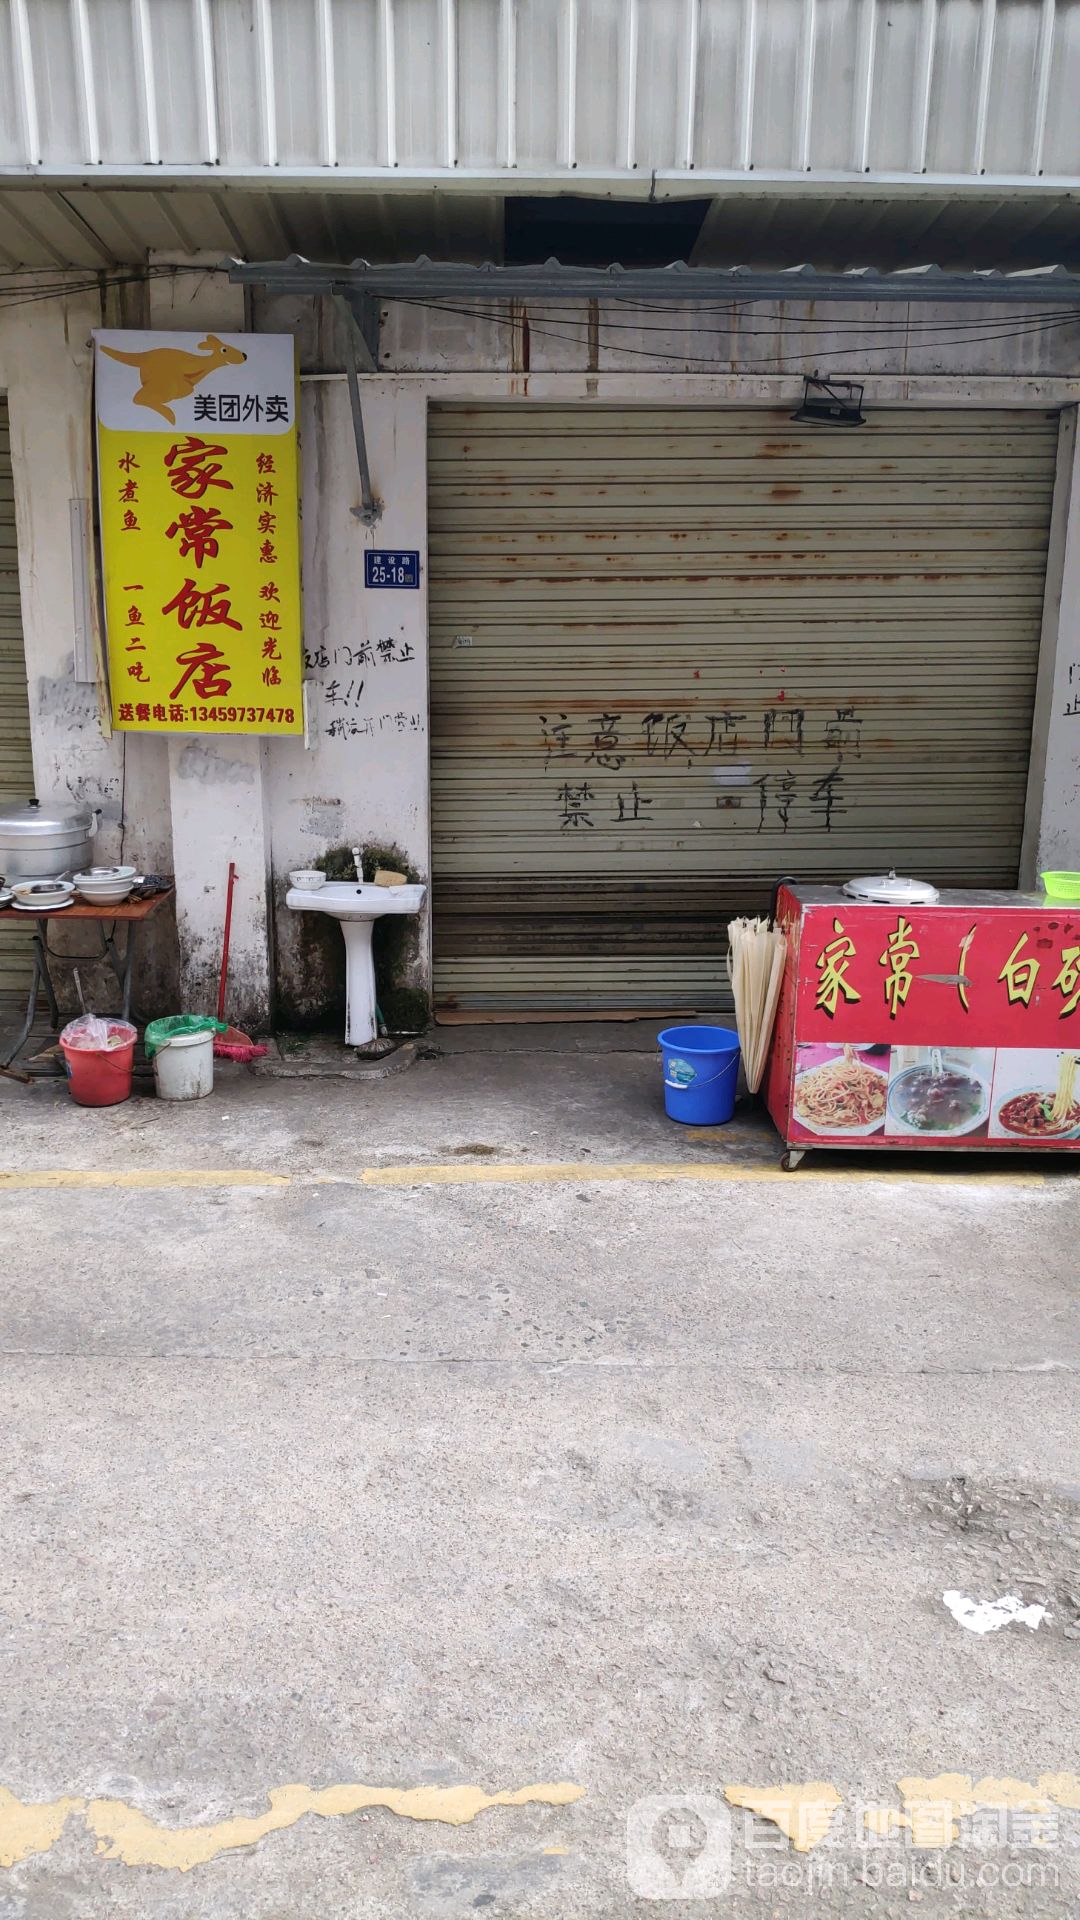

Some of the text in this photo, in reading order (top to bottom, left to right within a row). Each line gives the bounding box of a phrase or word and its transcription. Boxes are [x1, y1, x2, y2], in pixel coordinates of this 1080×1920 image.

[193, 393, 289, 423] 美团外卖
[117, 451, 151, 683] 水煮鱼 一鱼二吃
[161, 436, 243, 700] 家常饭店
[255, 452, 283, 688] 经济实惠 欢迎光临
[372, 566, 405, 583] 25-18
[373, 556, 410, 566] 建设路
[557, 780, 655, 829] 禁止
